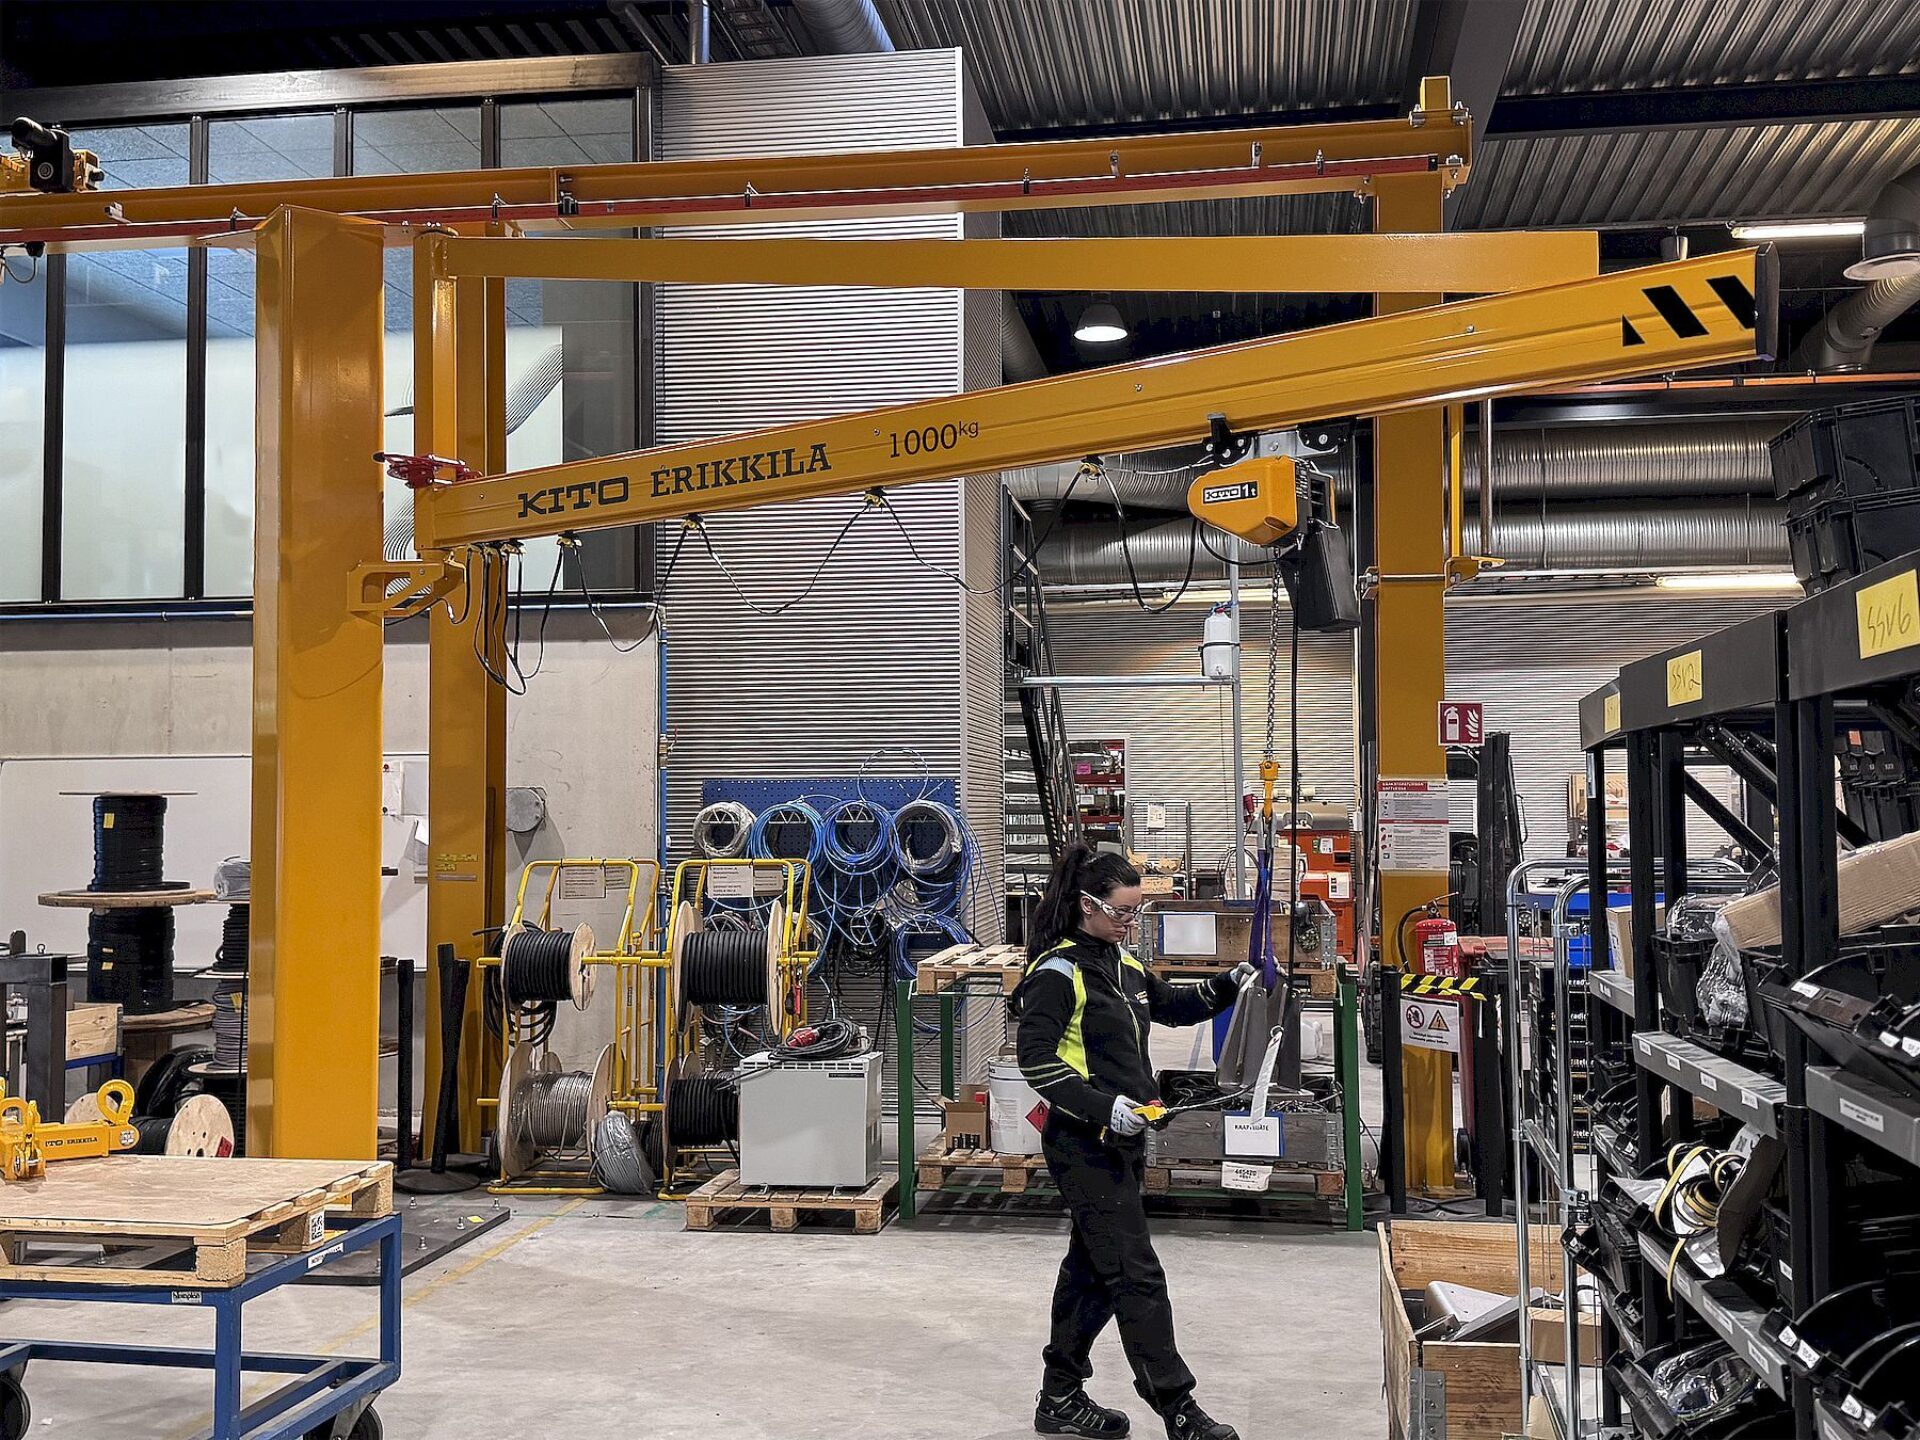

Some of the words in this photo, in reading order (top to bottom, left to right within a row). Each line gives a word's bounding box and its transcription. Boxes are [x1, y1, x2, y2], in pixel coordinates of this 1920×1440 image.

[517, 476, 629, 518] KITO
[1206, 488, 1239, 499] KITO
[1867, 592, 1912, 649] SSV6
